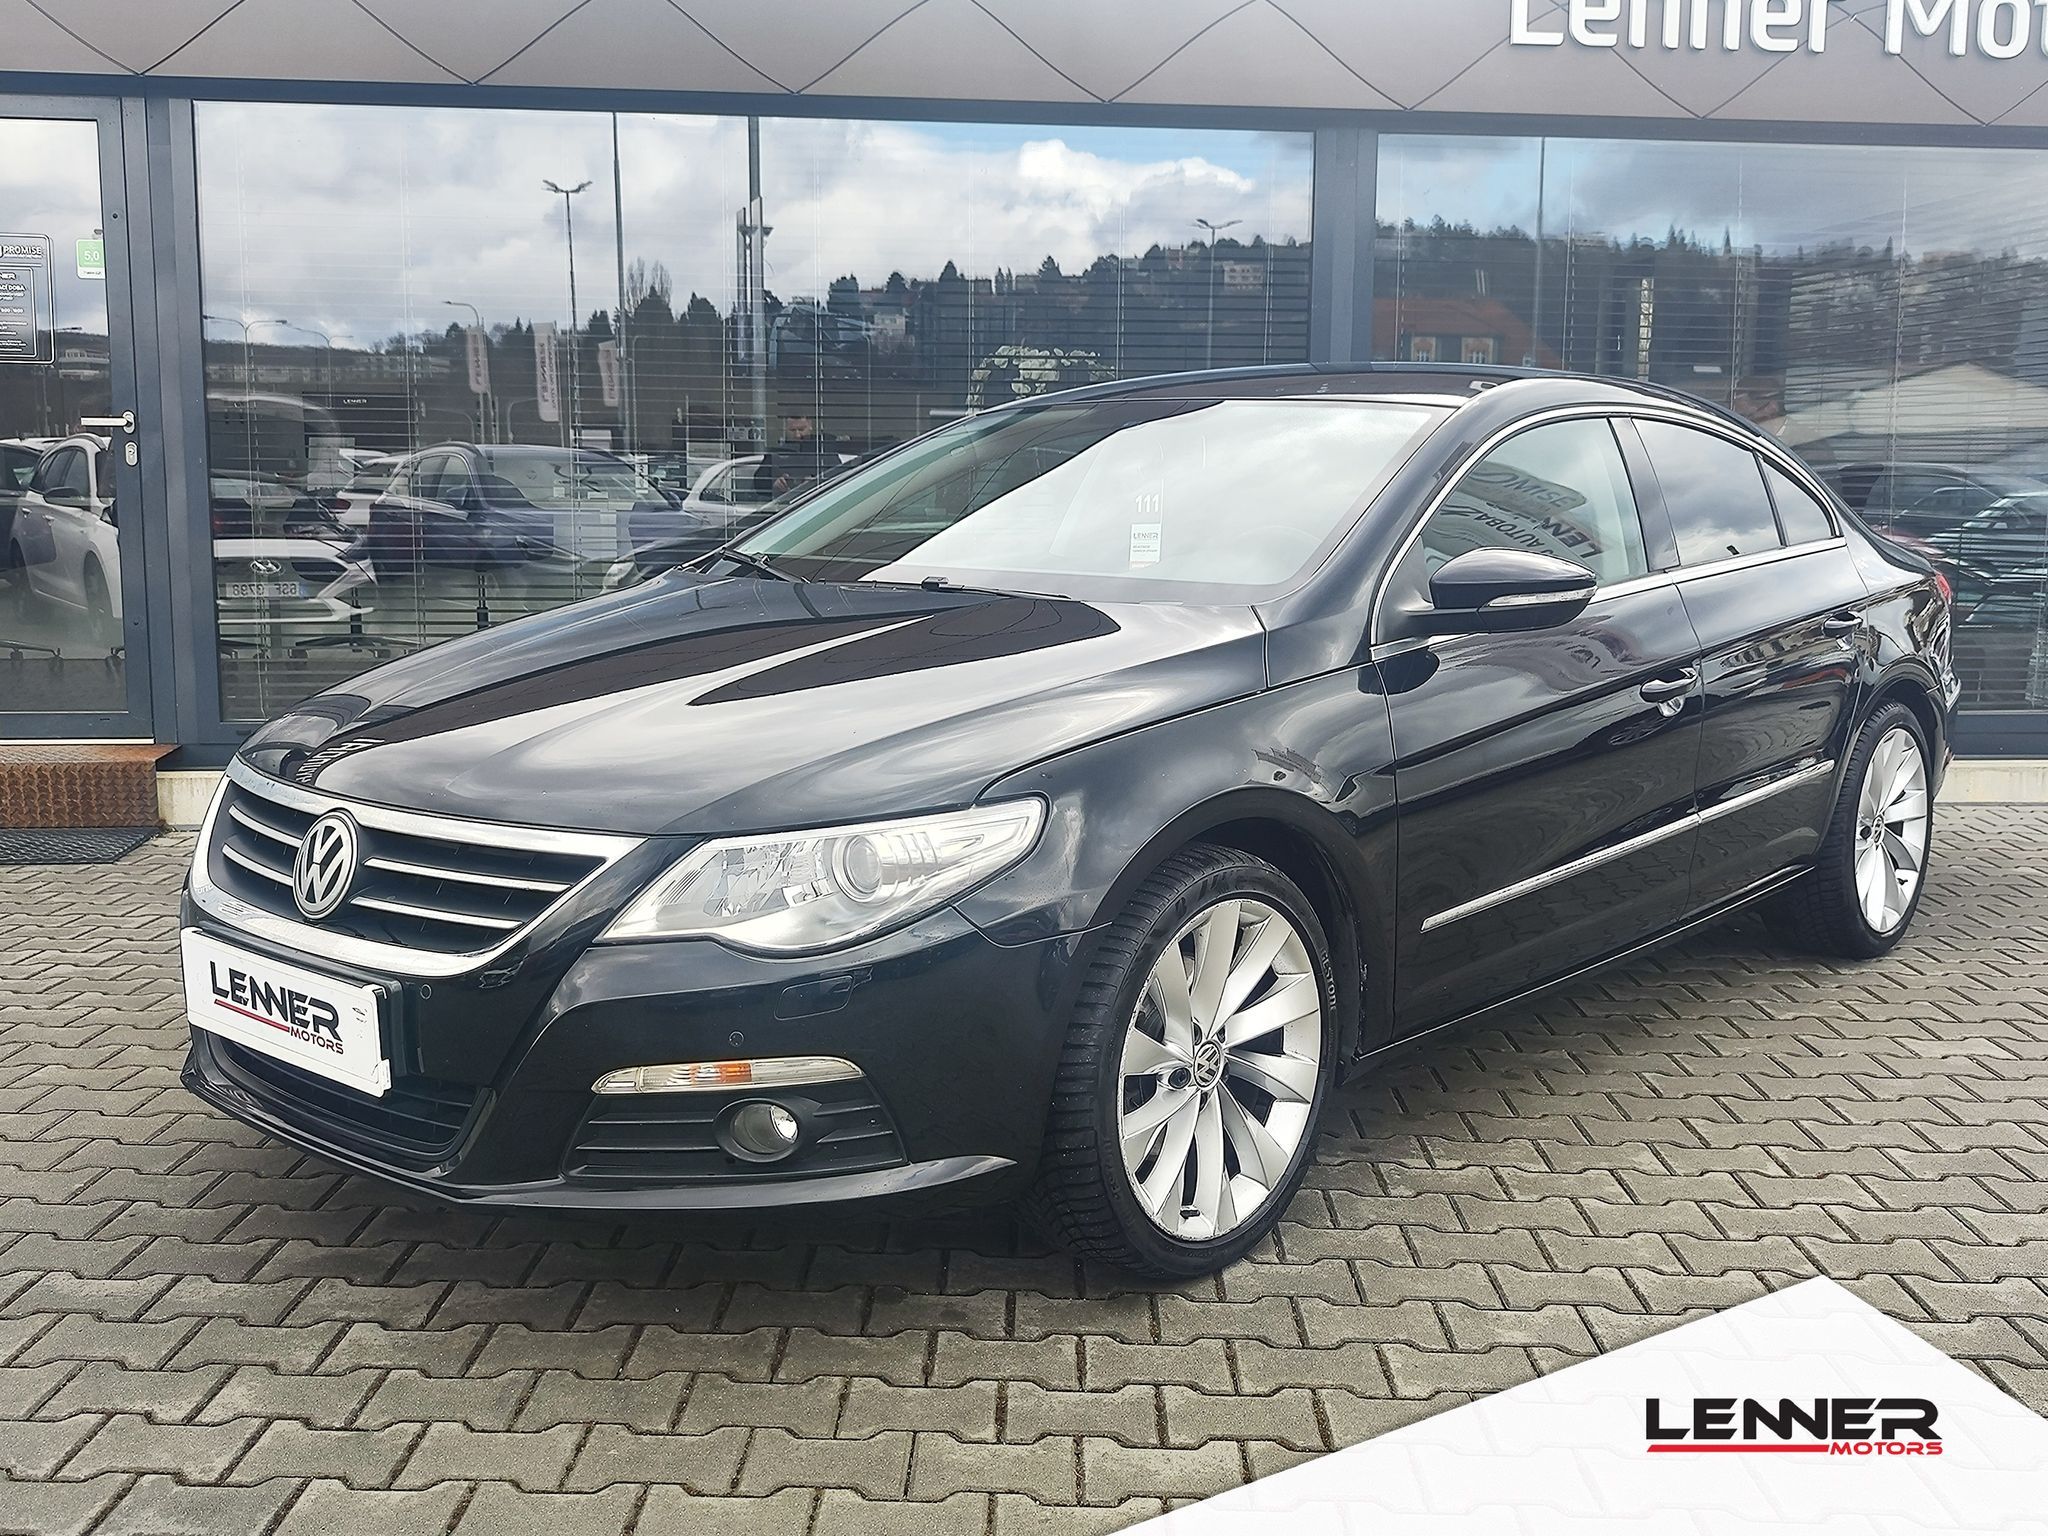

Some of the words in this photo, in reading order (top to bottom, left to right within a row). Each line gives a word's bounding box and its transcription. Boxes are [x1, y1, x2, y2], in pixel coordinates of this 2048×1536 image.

[1509, 0, 1826, 54] Lenner
[3, 245, 42, 255] PROMISE
[1135, 493, 1160, 513] 111
[210, 960, 343, 1043] LENNER
[290, 1026, 344, 1055] MOTORS
